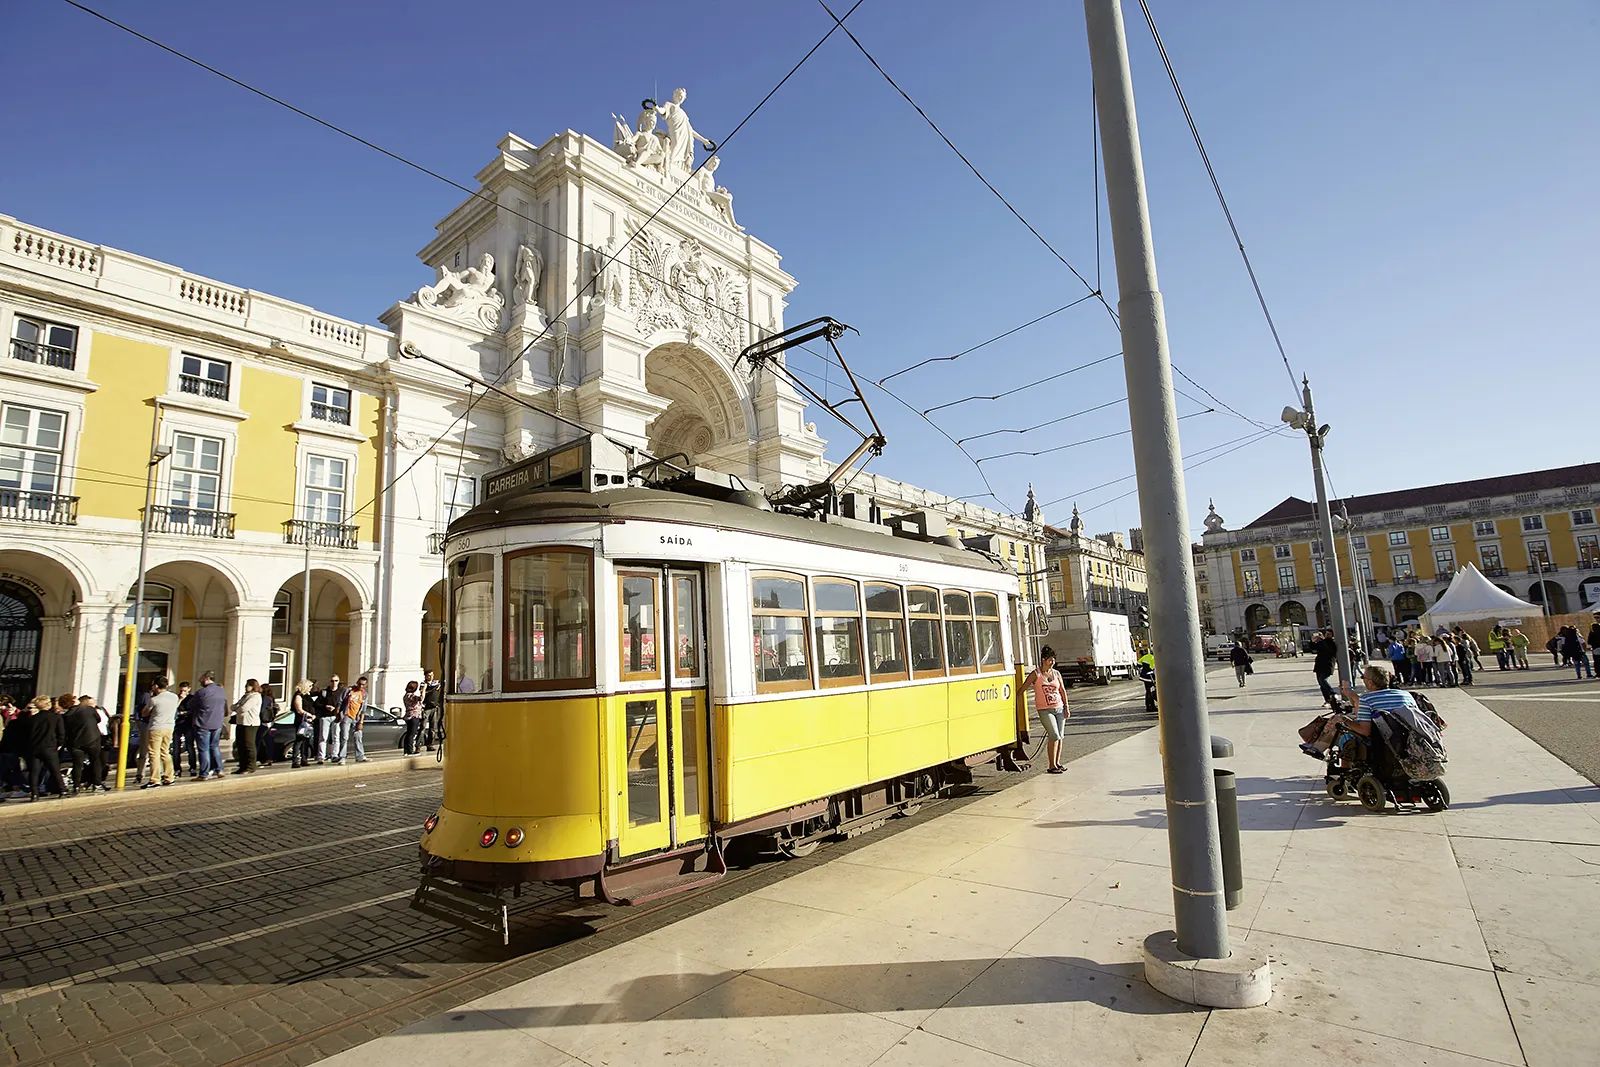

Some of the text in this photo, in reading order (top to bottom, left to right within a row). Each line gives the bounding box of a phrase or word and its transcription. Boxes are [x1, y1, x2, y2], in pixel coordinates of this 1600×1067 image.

[489, 470, 529, 495] CARREIRA
[458, 537, 470, 550] 560
[899, 563, 908, 572] 560
[976, 683, 998, 702] carris
